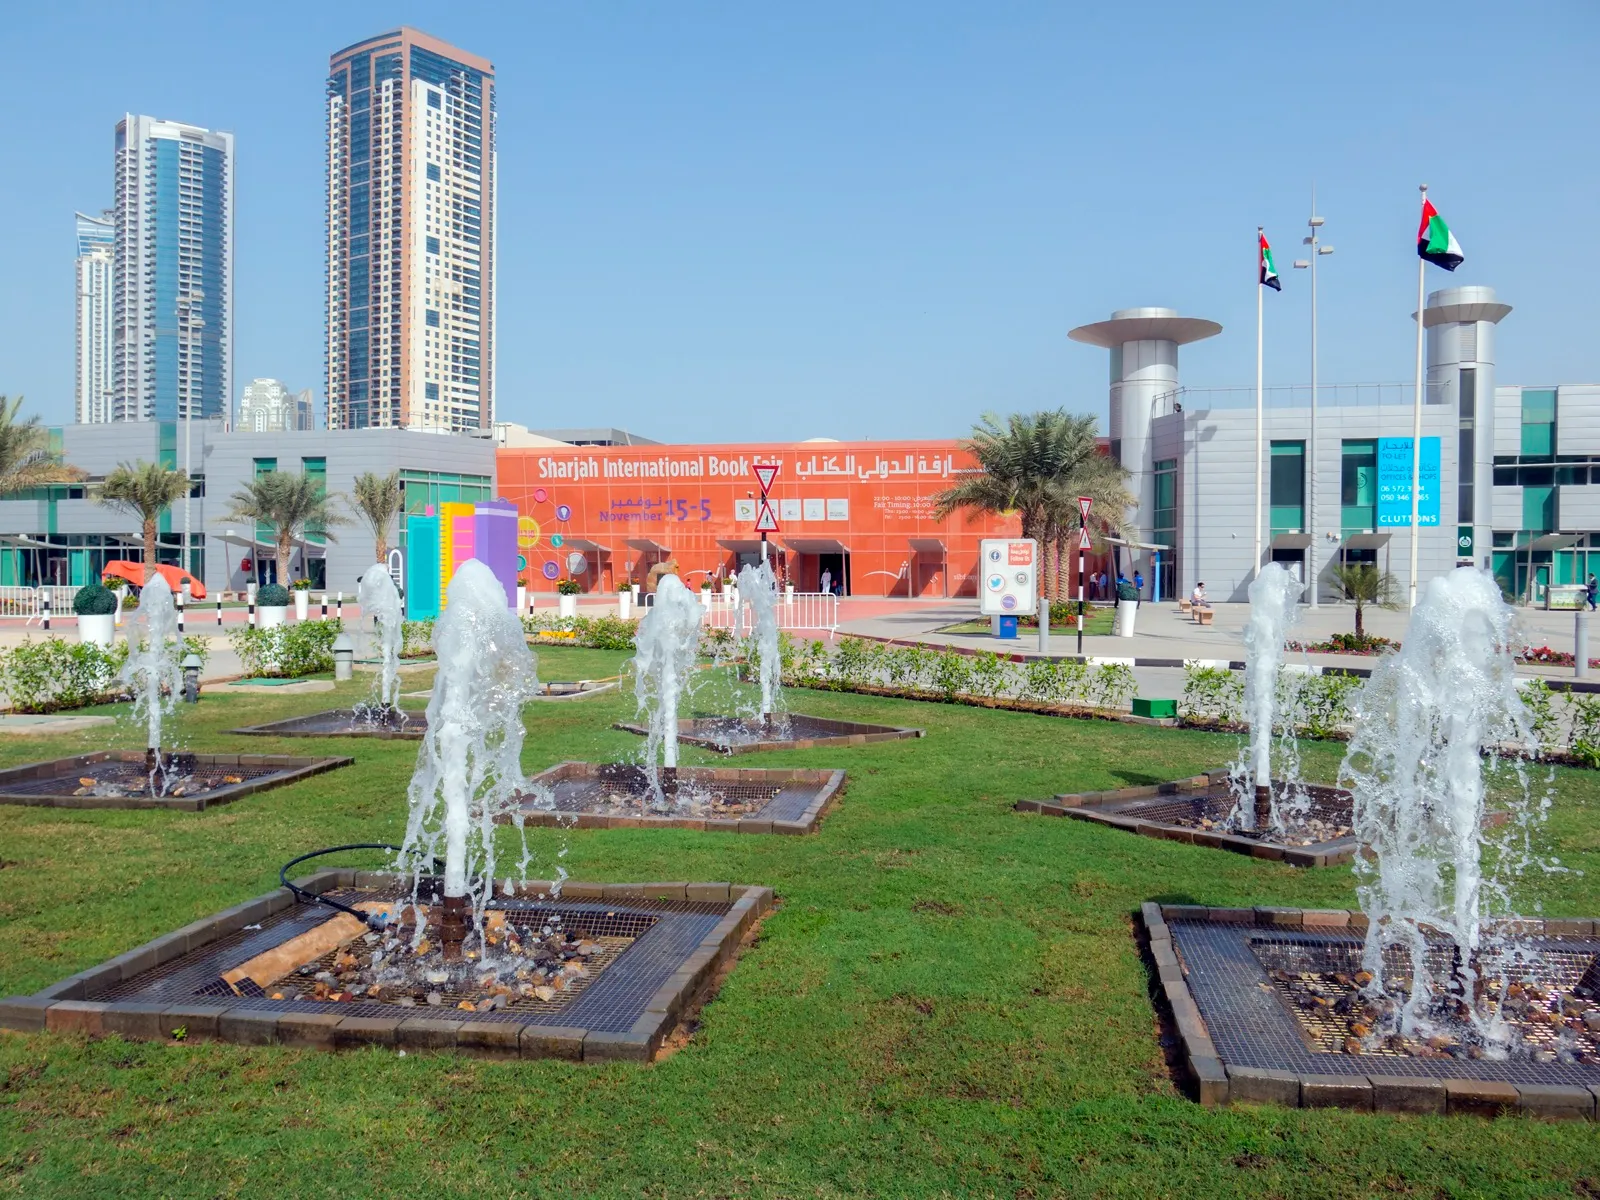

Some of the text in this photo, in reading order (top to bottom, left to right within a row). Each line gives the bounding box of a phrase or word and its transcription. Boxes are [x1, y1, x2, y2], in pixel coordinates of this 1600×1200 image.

[538, 457, 599, 481] Sharjah
[603, 456, 704, 478] International
[708, 455, 749, 476] Book
[795, 455, 855, 480] للكتاب
[858, 455, 914, 483] الدولي
[600, 511, 662, 521] November
